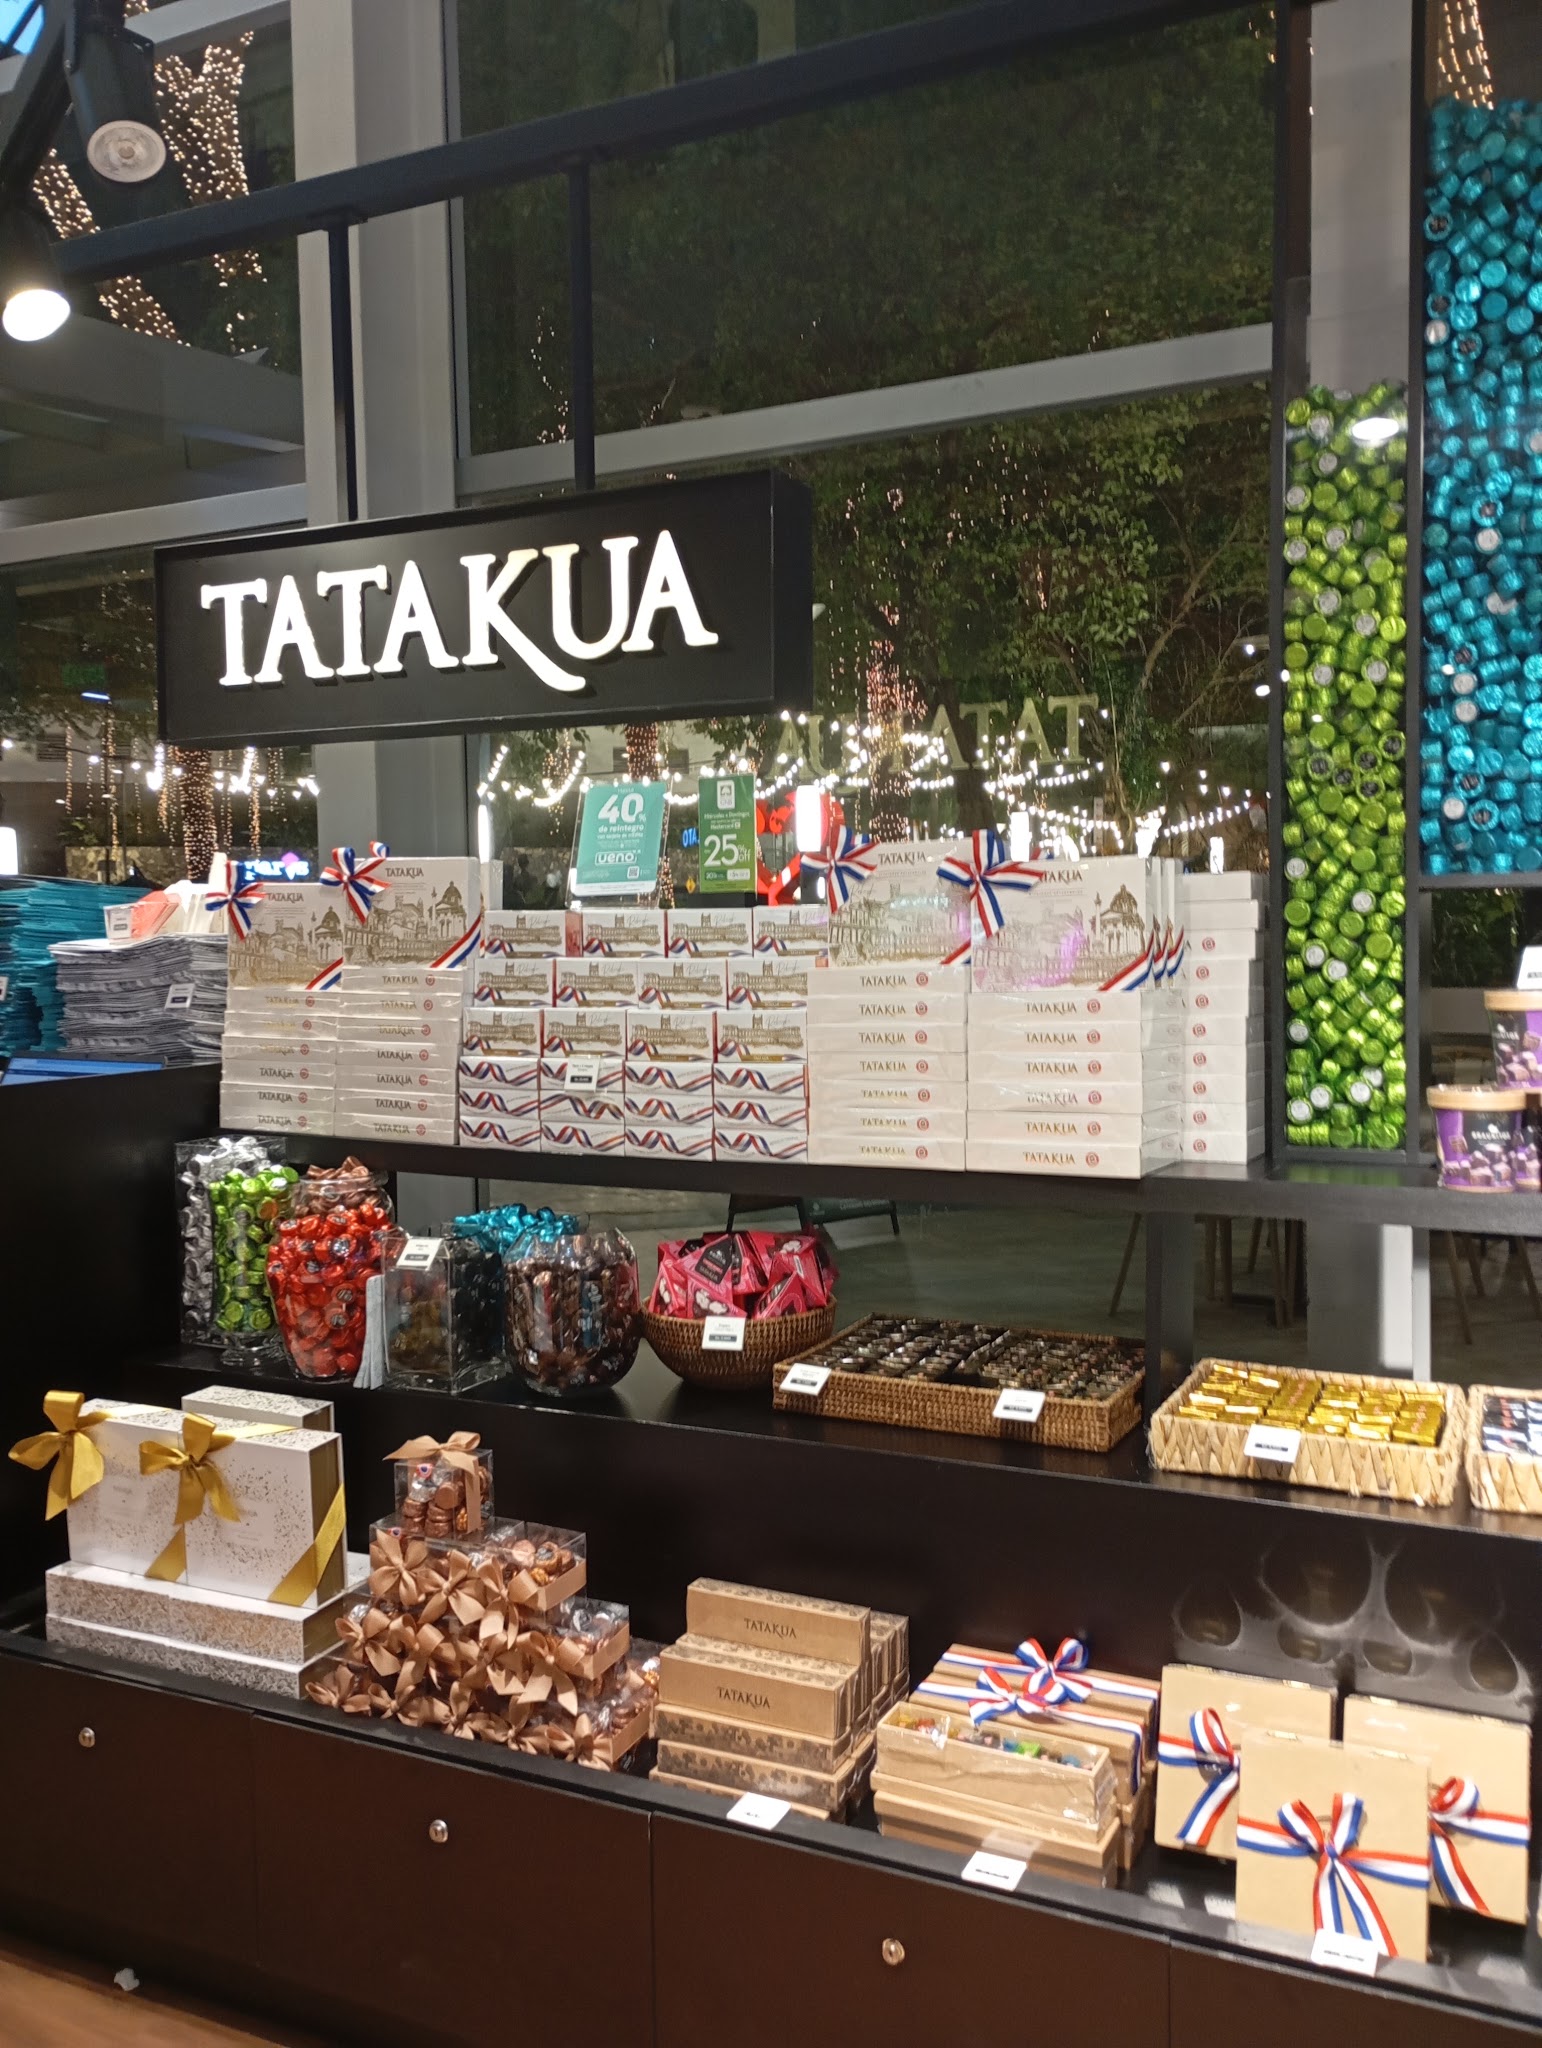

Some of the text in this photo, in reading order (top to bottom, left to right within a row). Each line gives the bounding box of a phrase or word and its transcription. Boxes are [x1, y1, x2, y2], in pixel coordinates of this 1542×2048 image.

[200, 529, 720, 692] TATAKUA
[598, 823, 645, 834] de reintegro
[597, 851, 635, 864] ueno
[878, 852, 927, 865] TATAKUA
[385, 867, 424, 879] TATAKUA
[1039, 868, 1083, 884] TAKUA
[267, 892, 304, 903] TATAKUA
[860, 975, 907, 989] TATAKUA
[859, 1003, 907, 1017] TATAKUA
[1026, 1001, 1078, 1016] TATAKUA
[858, 1032, 906, 1046] TATAKUA
[1026, 1031, 1078, 1046] TATAKUA
[377, 1050, 413, 1061] TATAKUA
[259, 1067, 294, 1079] TATAKUA
[859, 1061, 907, 1075] TATAKUA
[1025, 1062, 1078, 1076] TATAKUA
[376, 1075, 413, 1086] TATAKUA
[257, 1091, 293, 1102] TATAKUA
[375, 1099, 412, 1110] TATAKUA
[1024, 1122, 1078, 1136] TATAKUA
[1023, 1152, 1076, 1166] TATAKUA
[744, 1618, 797, 1640] TATAKUA
[716, 1686, 772, 1710] TATAKUA
